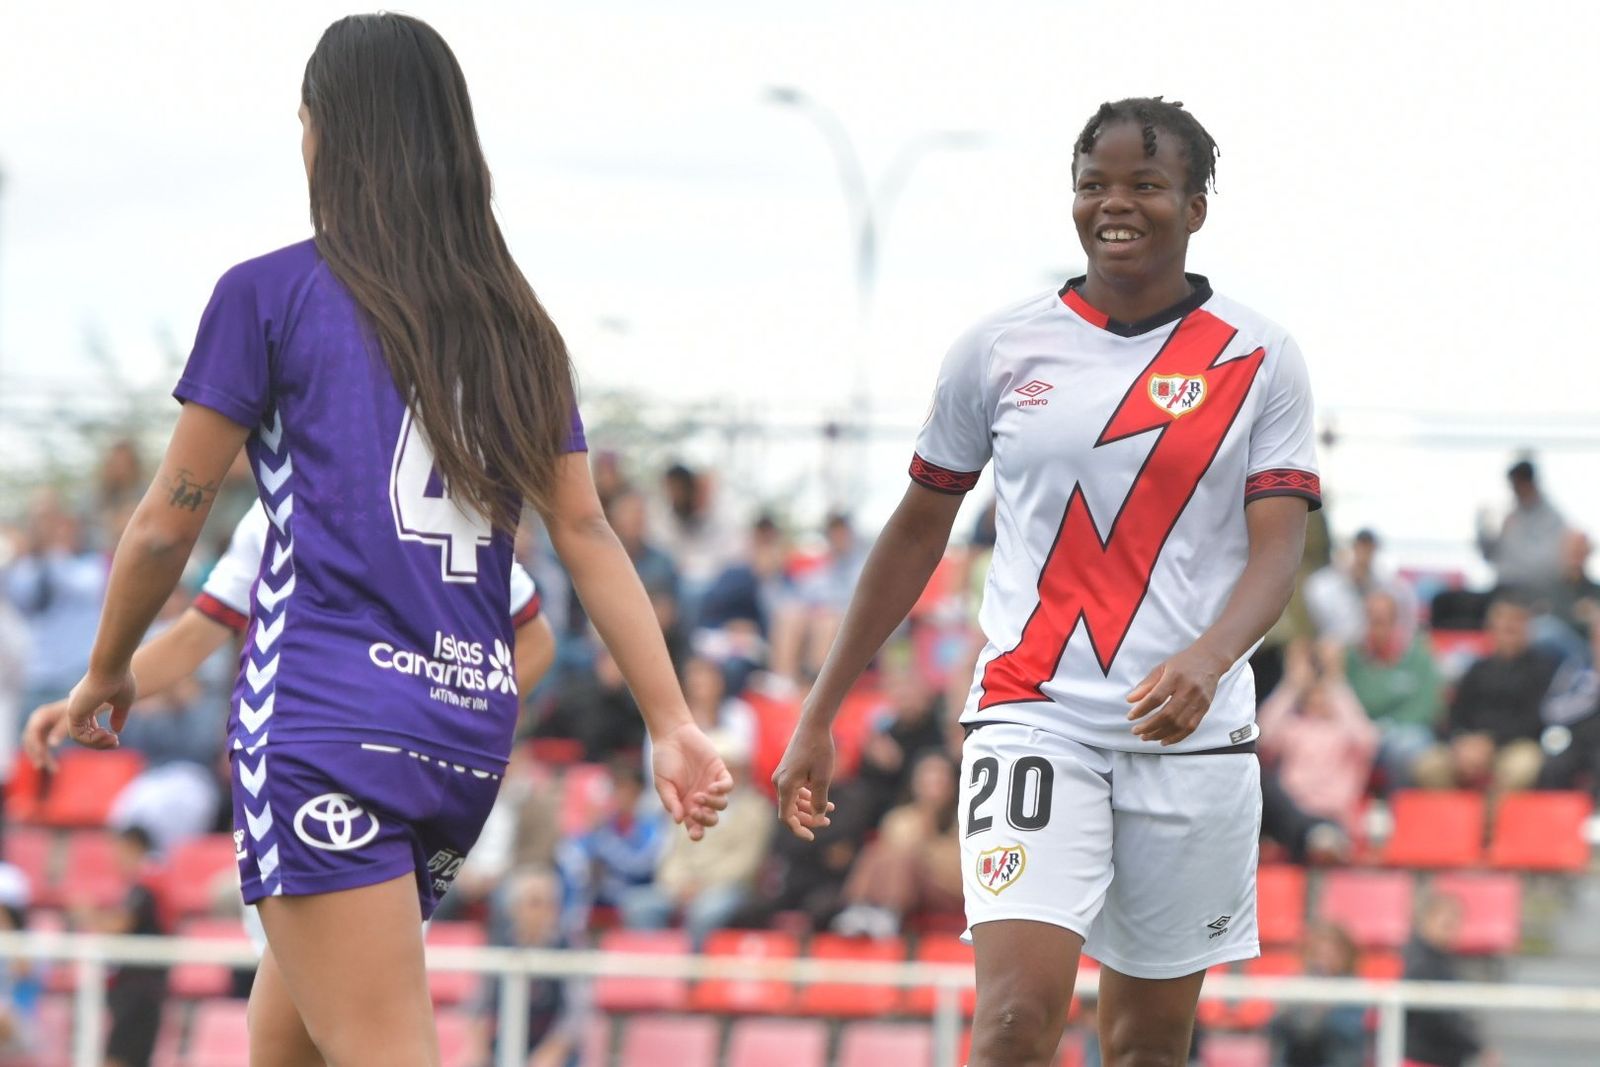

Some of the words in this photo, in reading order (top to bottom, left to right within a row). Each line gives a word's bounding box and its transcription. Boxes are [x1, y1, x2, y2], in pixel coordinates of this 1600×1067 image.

[1016, 398, 1048, 408] umbro
[389, 378, 492, 584] 4
[368, 642, 487, 692] Canarias
[434, 630, 484, 665] Islas
[472, 697, 488, 712] VIDA
[965, 755, 1055, 839] 20
